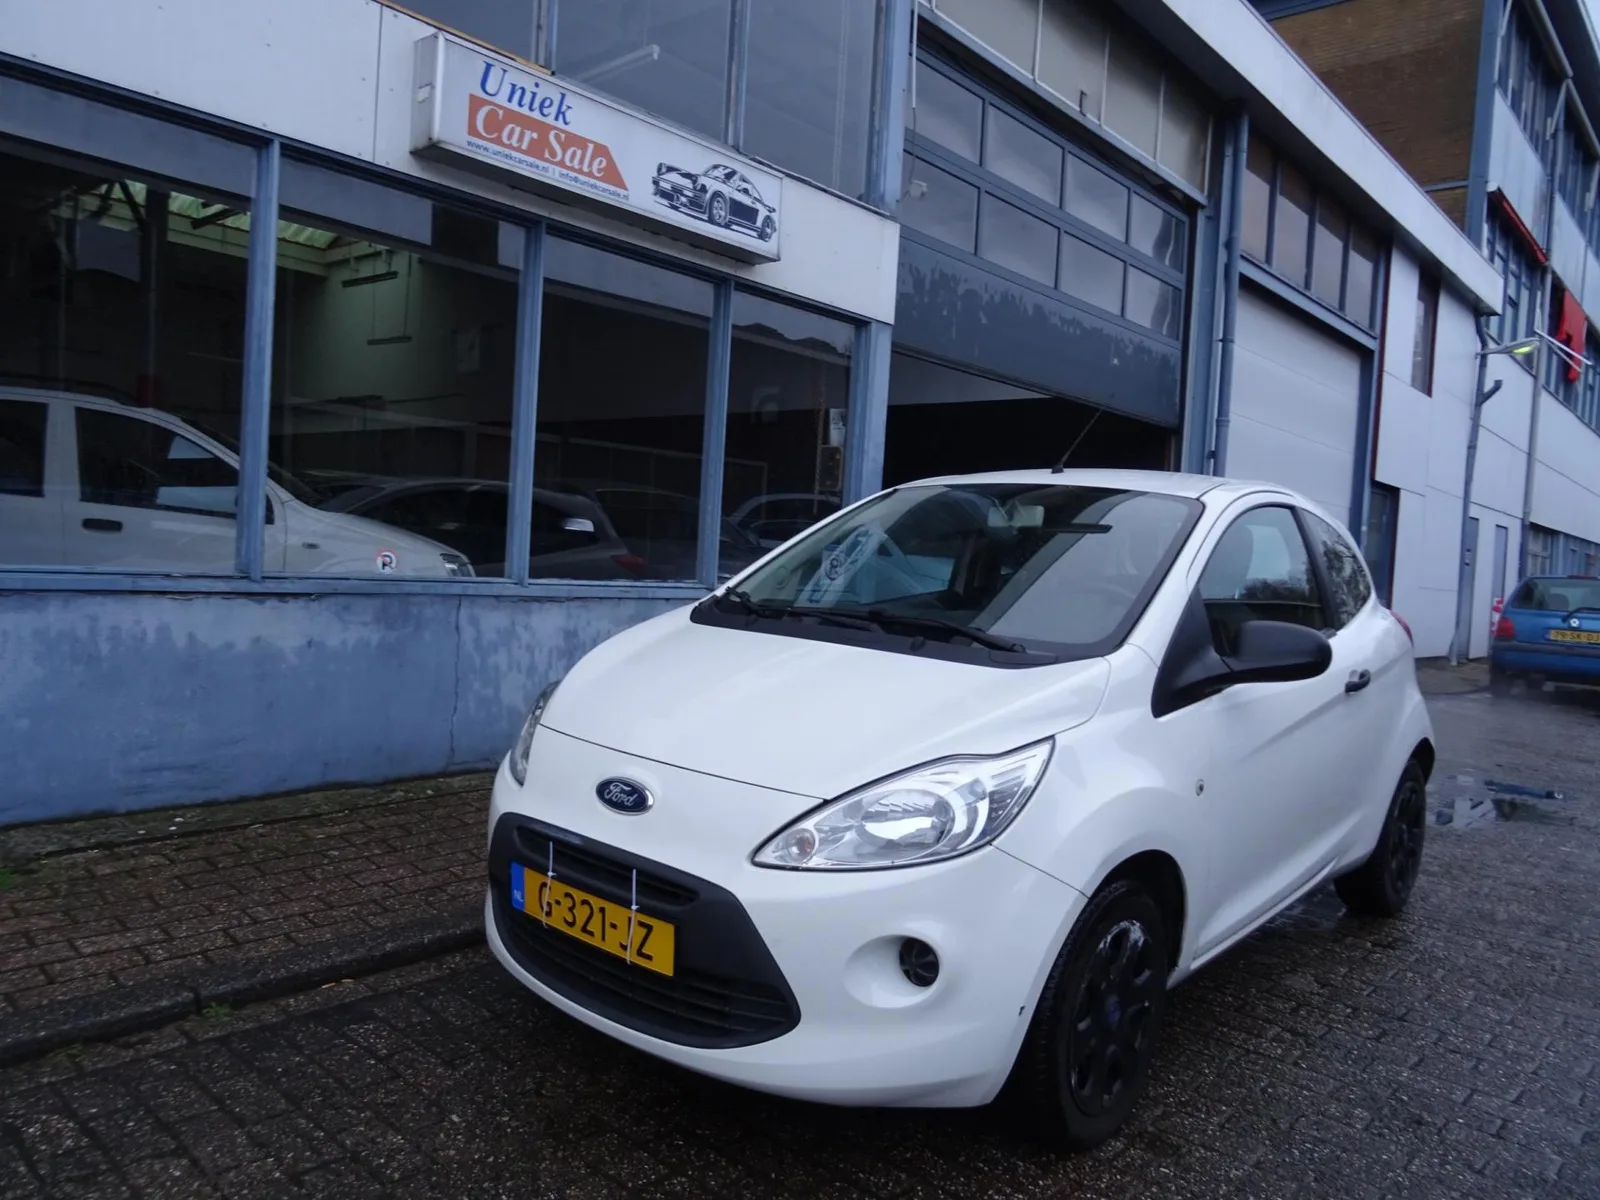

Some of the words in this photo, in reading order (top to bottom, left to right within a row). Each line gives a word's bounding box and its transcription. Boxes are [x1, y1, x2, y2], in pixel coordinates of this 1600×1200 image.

[480, 60, 573, 126] Uniek
[466, 139, 550, 174] www.uniekcarsale.nl
[475, 104, 538, 152] Car
[544, 129, 608, 178] Sale
[603, 781, 639, 807] Ford
[538, 881, 654, 962] G-321-JZ
